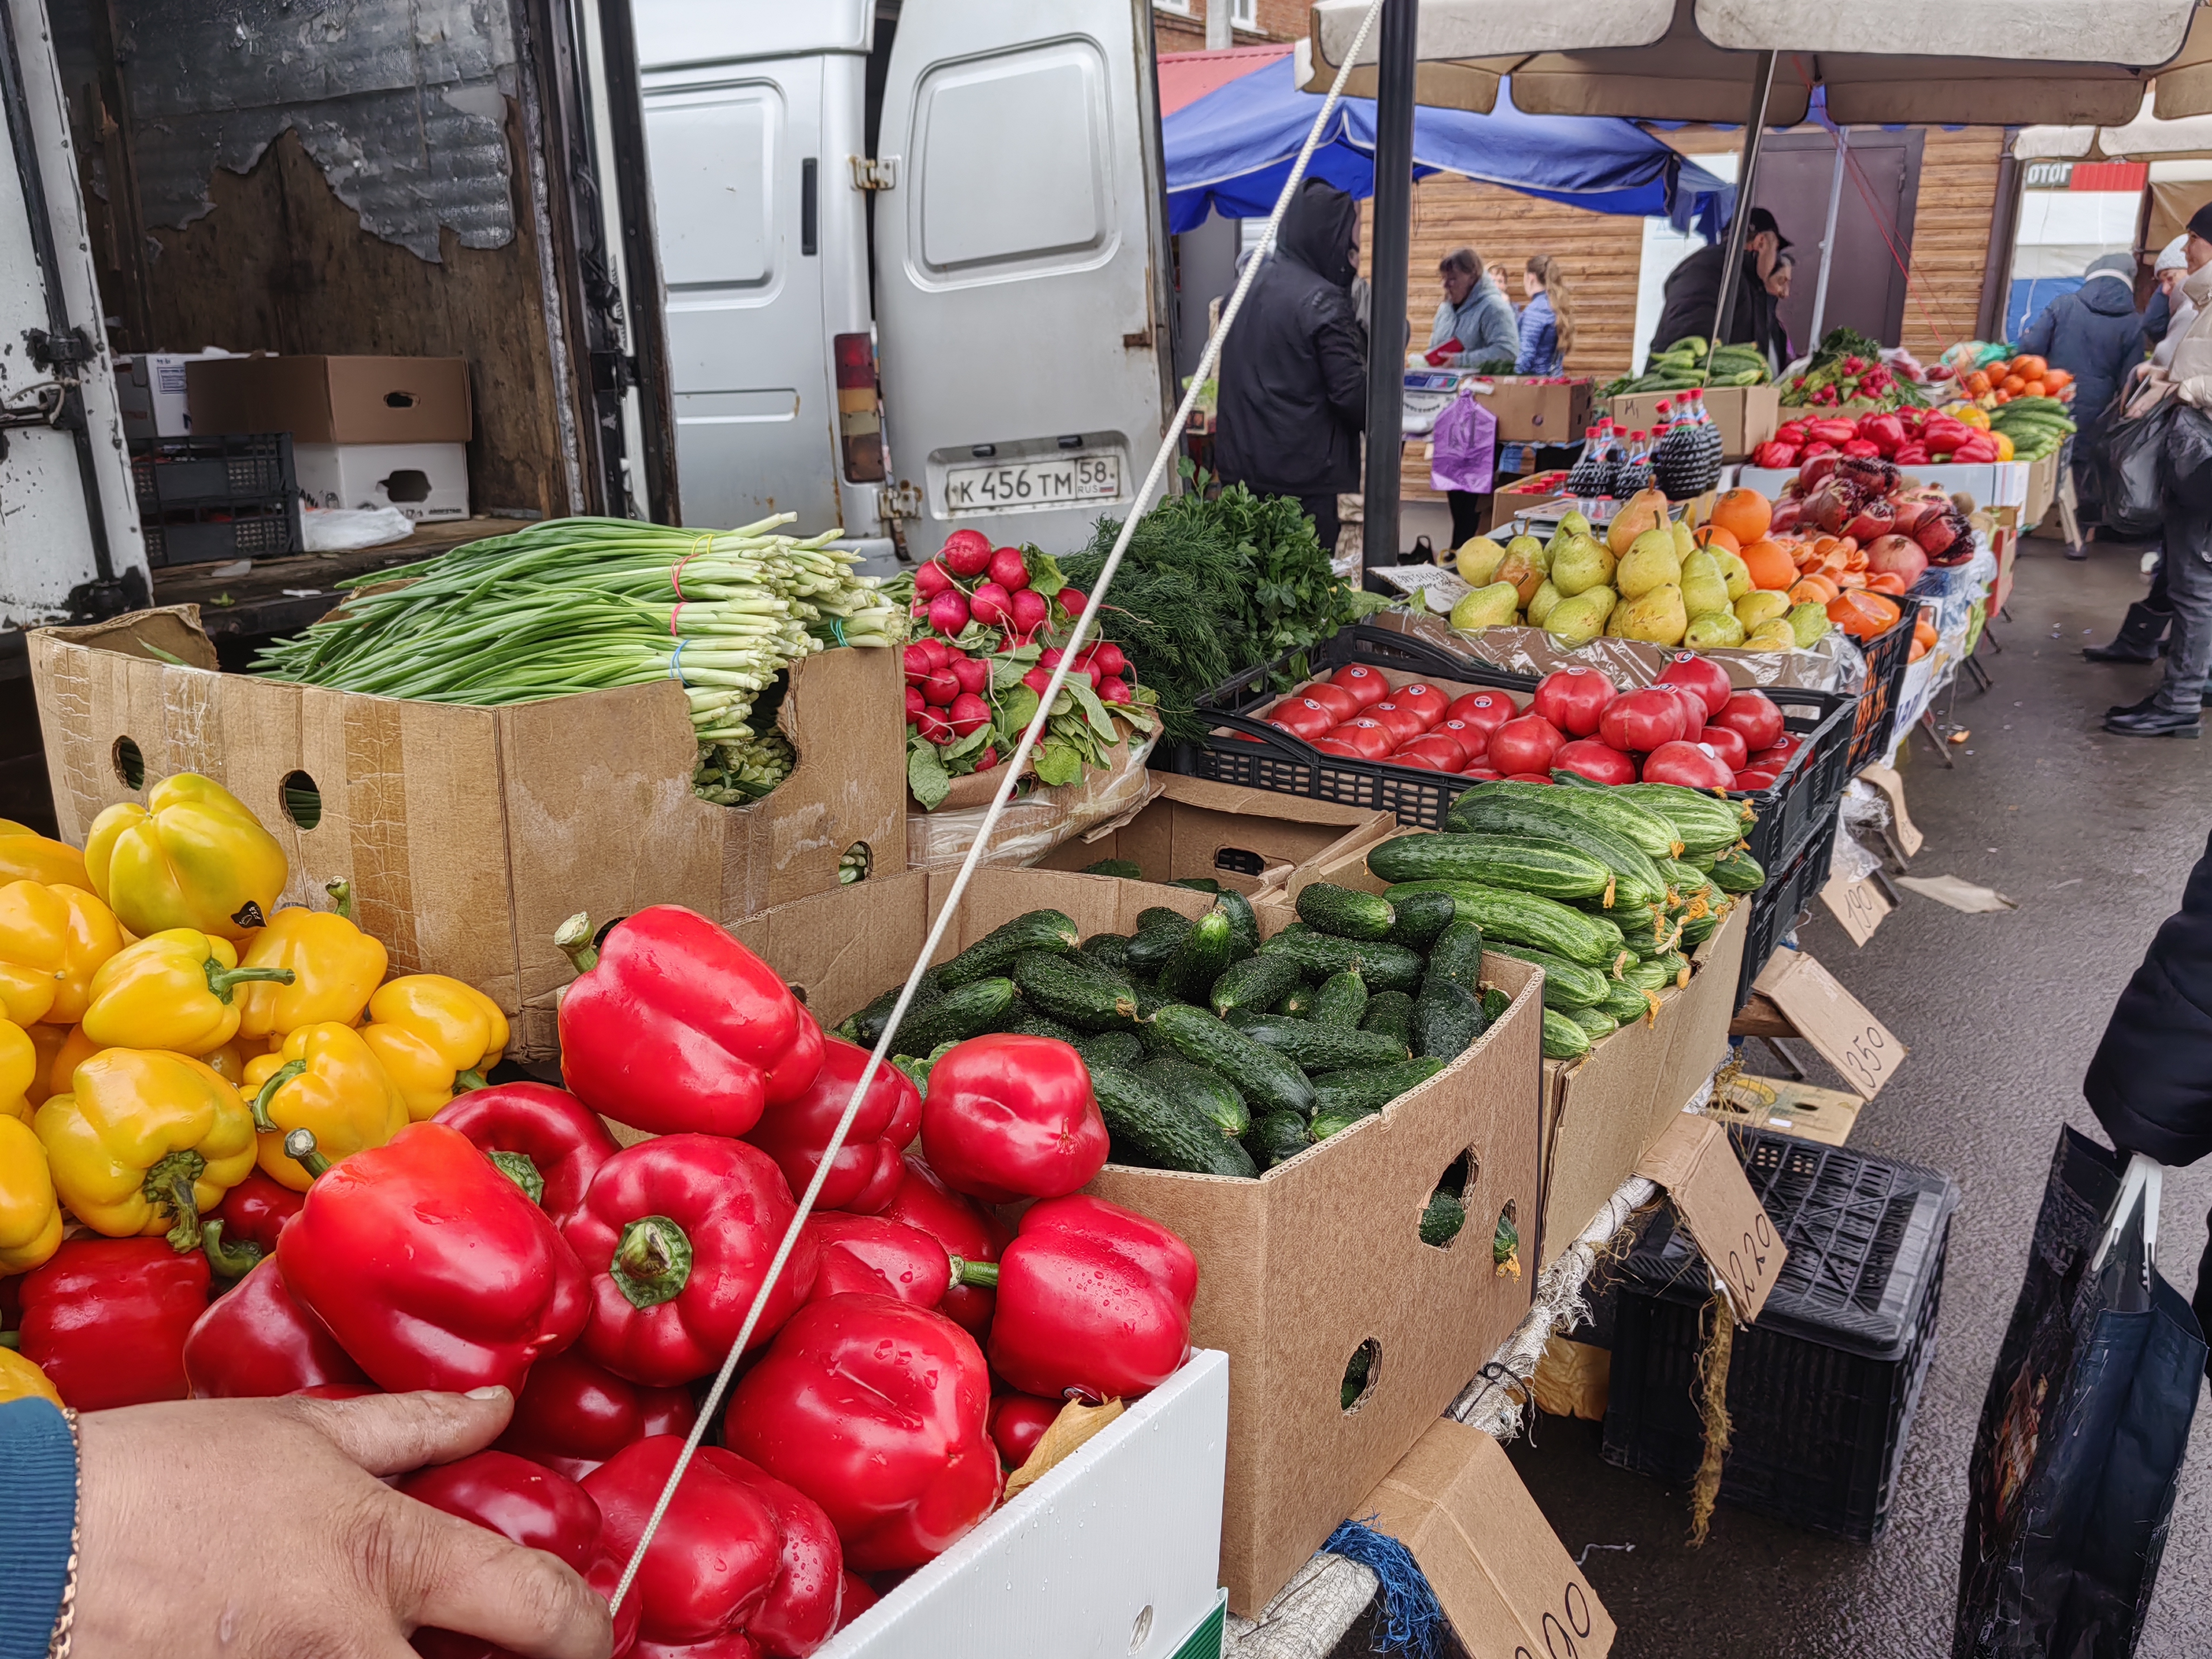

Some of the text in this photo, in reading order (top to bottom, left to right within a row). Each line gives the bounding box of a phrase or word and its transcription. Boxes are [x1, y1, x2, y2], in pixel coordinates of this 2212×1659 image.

[1078, 484, 1098, 494] RUS
[1080, 461, 1107, 484] 58
[1844, 885, 1872, 937] 190
[1846, 1027, 1884, 1088] 350
[1729, 1213, 1770, 1309] 220
